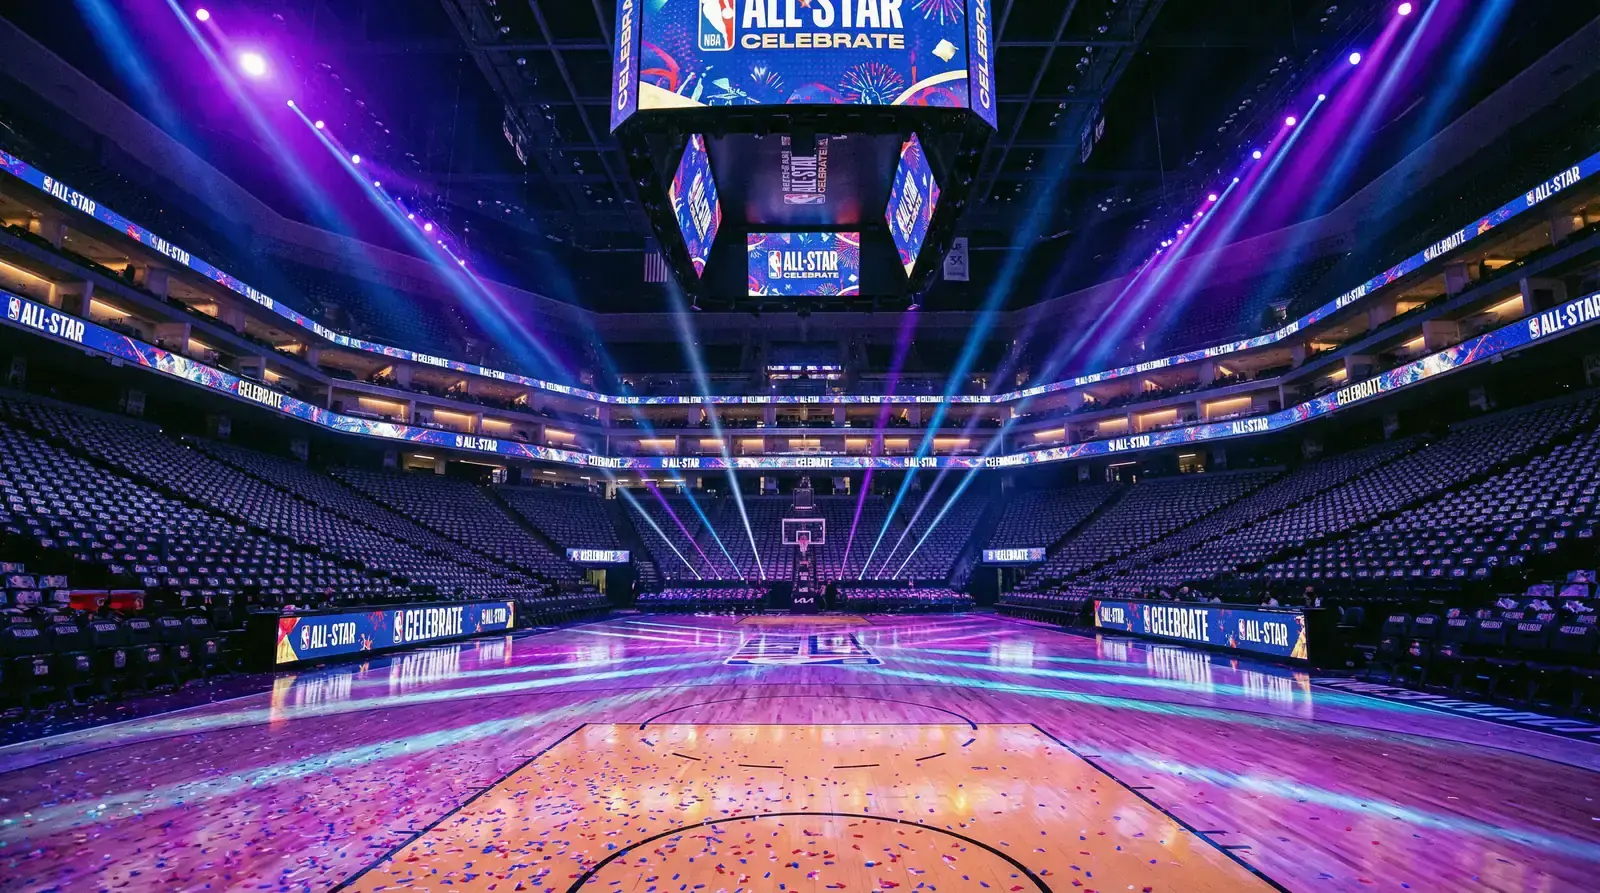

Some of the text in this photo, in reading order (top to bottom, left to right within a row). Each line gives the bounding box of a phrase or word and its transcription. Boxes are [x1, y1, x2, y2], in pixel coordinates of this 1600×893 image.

[704, 34, 721, 46] NBA
[741, 33, 905, 49] CELEBRATE
[1535, 166, 1580, 203] ALL-STAR
[51, 181, 96, 216] ALL-STAR
[157, 237, 190, 266] ALL-STAR
[784, 251, 838, 271] ALL-STAR
[20, 302, 85, 343] ALL-STAR
[238, 380, 282, 409] CELEBRATE
[1337, 377, 1382, 405] CELEBRATE
[1232, 418, 1269, 434] ALL-STAR
[464, 437, 498, 452] ALL-STAR
[1115, 435, 1150, 451] ALL-STAR
[668, 458, 700, 468] ALL-STAR
[796, 457, 833, 467] CELEBRATE
[311, 622, 356, 649] ALL-STAR
[405, 607, 464, 641] CELEBRATE
[1152, 607, 1209, 641] CELEBRATE
[1246, 621, 1288, 646] ALL-STAR
